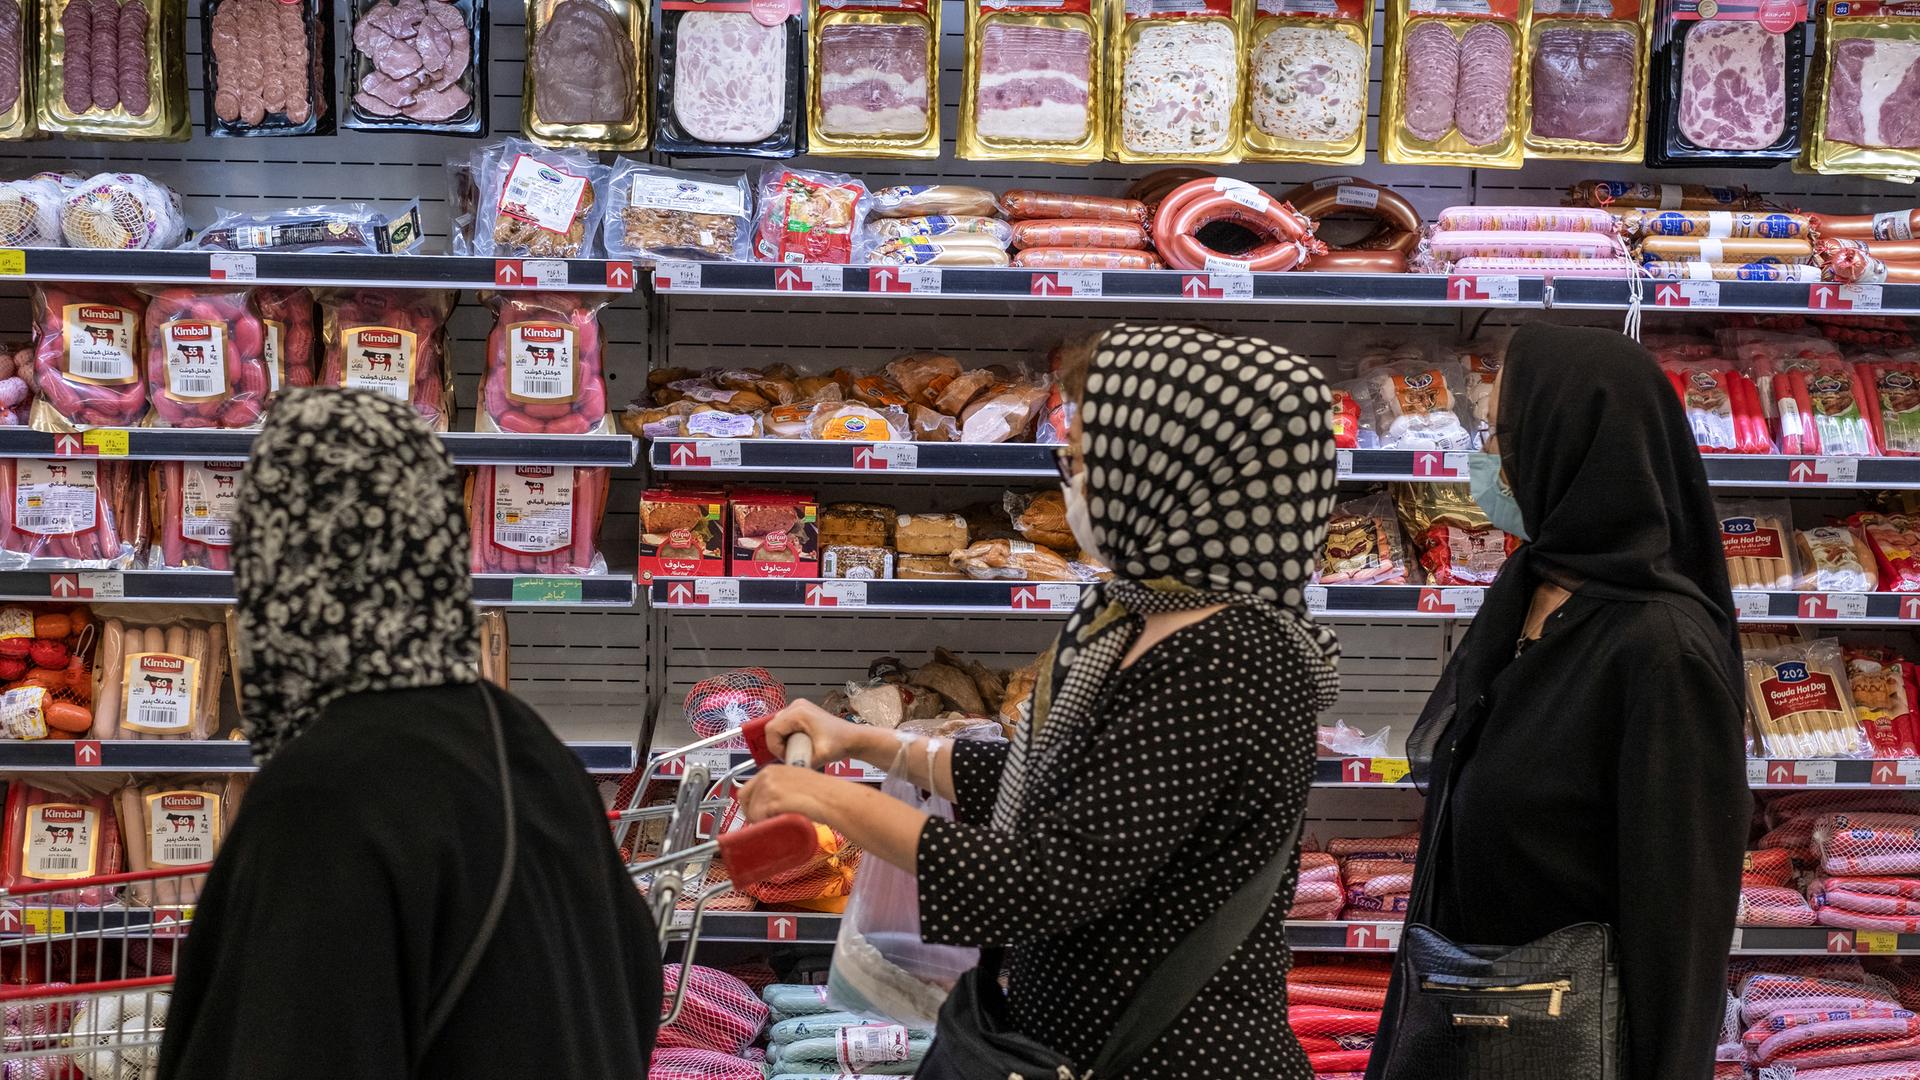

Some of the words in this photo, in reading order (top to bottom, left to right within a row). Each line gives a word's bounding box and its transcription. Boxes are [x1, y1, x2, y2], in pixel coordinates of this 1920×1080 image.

[82, 308, 120, 319] Kimball
[121, 328, 127, 336] 1
[174, 326, 209, 336] Kimball
[524, 328, 561, 338] Kimball
[361, 332, 399, 343] Kimball
[210, 344, 216, 352] 1
[562, 347, 568, 355] 1
[1728, 524, 1751, 532] 202
[1755, 535, 1771, 543] Dog
[539, 591, 566, 601] گیاهی
[144, 658, 182, 669] Kimball
[1782, 669, 1805, 679] 202
[180, 678, 186, 686] 1
[1770, 688, 1796, 699] Gouda
[1796, 685, 1810, 694] Hot
[1810, 682, 1826, 692] Dog
[164, 797, 202, 806] Kimball
[45, 809, 82, 819] Kimball
[81, 826, 87, 834] 1
